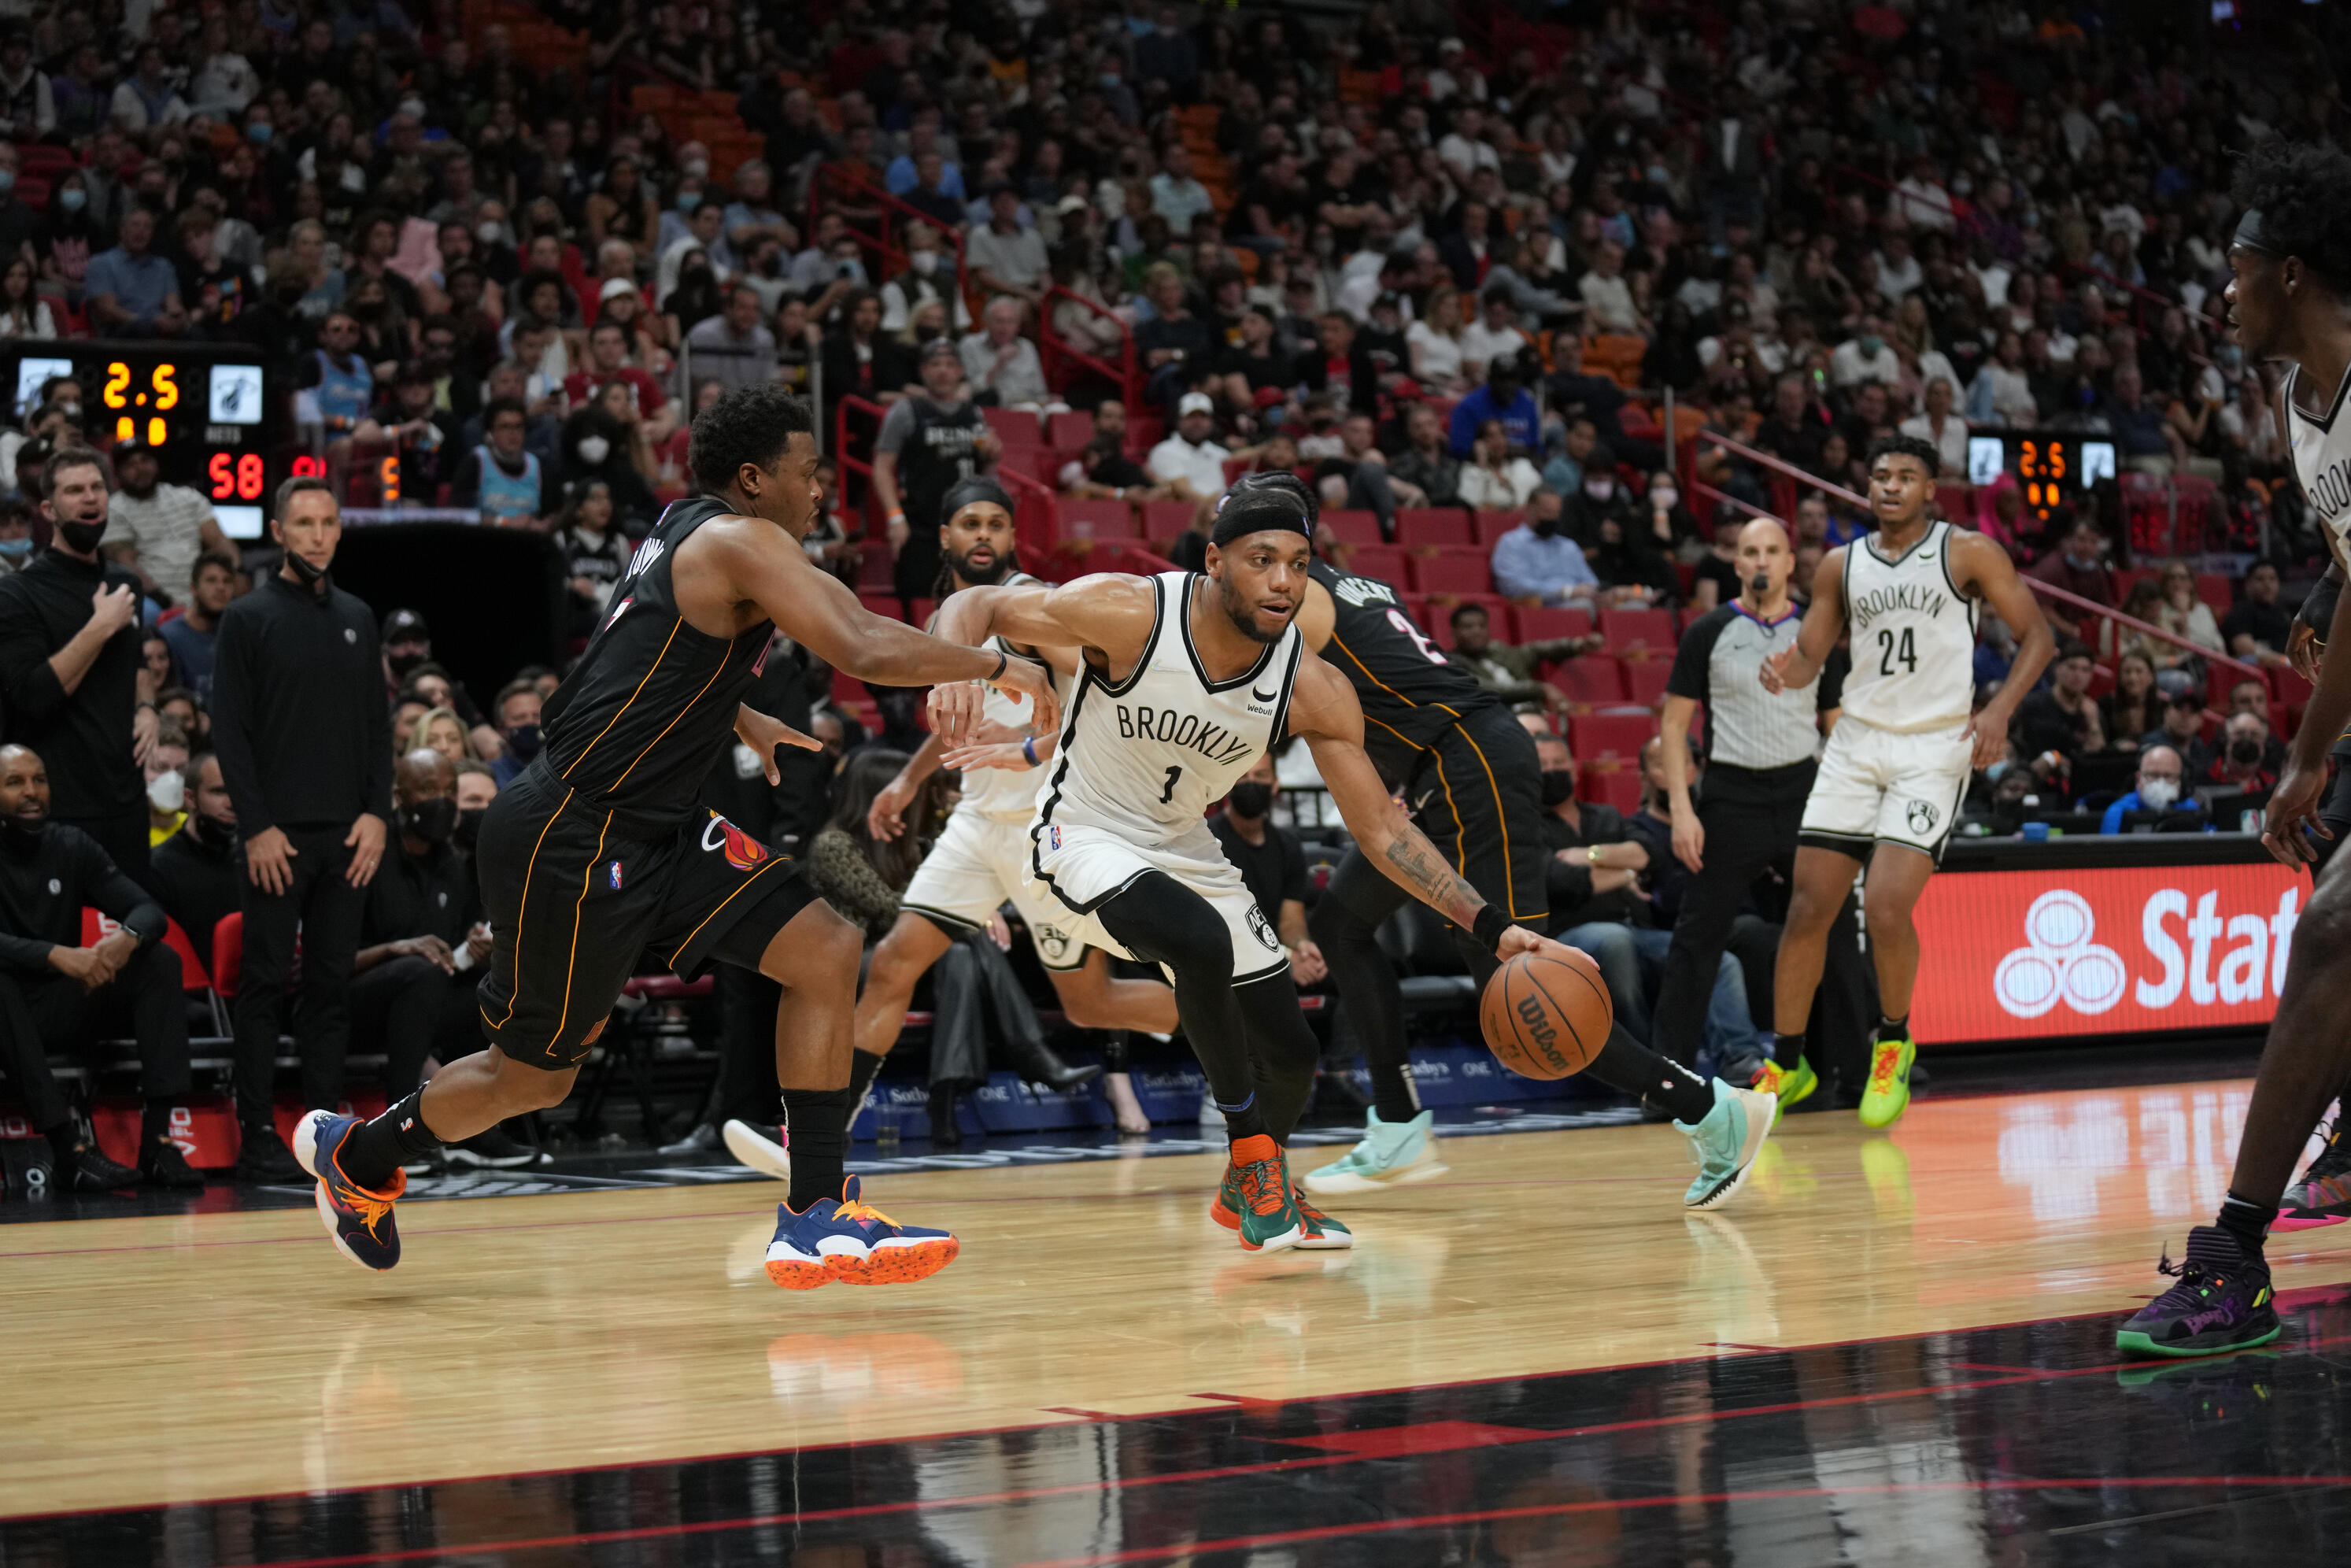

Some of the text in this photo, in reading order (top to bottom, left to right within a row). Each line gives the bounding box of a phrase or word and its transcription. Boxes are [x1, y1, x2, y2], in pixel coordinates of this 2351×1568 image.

[103, 361, 179, 410] 2.5
[209, 452, 264, 500] 58
[1854, 583, 1947, 629] BROOKLYN
[1386, 608, 1449, 665] 2
[1878, 627, 1917, 675] 24
[1247, 703, 1273, 716] Webull
[1116, 704, 1255, 766] BROOKLYN
[1159, 764, 1183, 804] 1
[2135, 885, 2301, 1009] Stat
[1517, 991, 1571, 1072] Wilson
